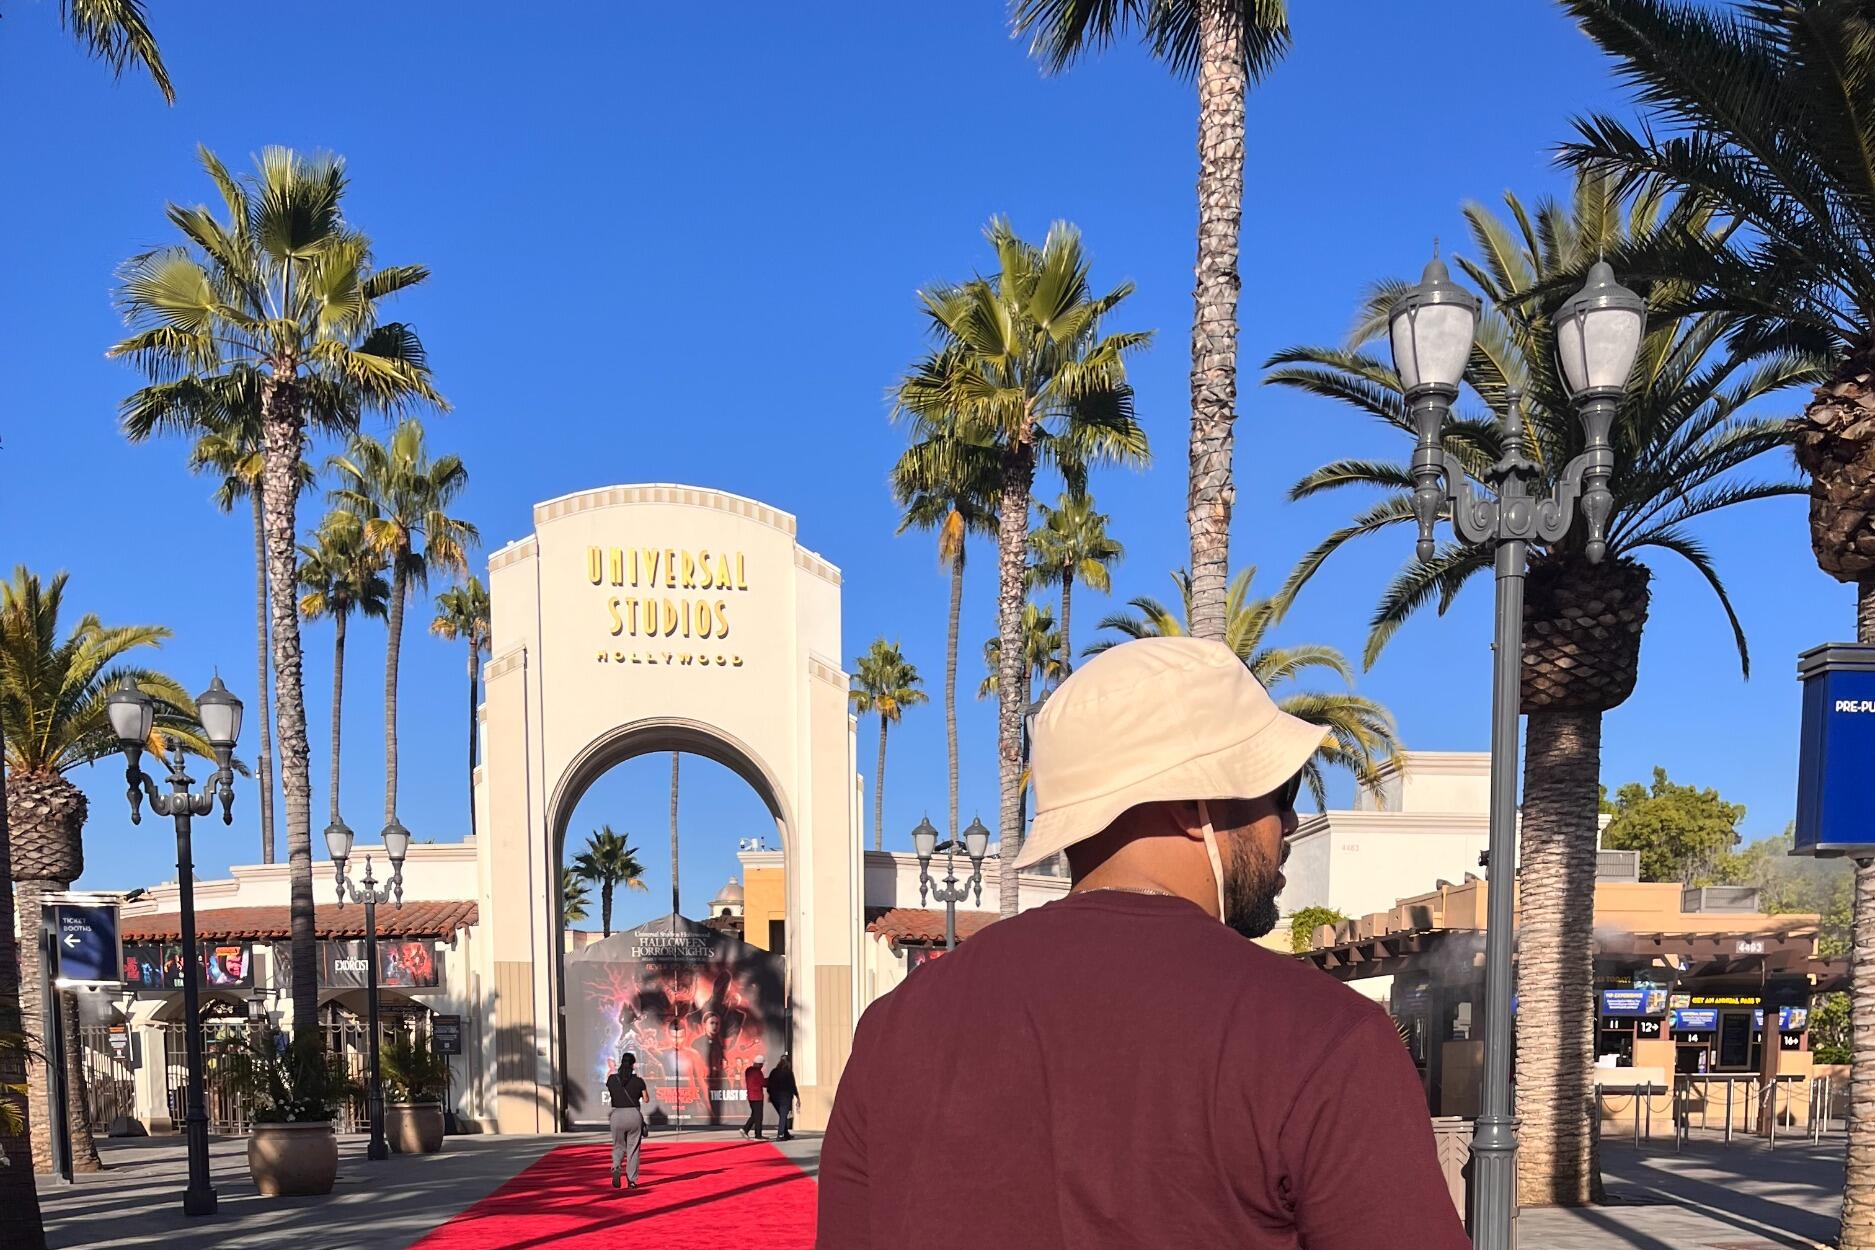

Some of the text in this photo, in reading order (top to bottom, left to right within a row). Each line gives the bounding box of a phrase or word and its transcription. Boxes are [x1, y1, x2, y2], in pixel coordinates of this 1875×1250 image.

[586, 546, 748, 591] UNIVERSAL
[607, 596, 729, 639] STUDIOS
[595, 650, 744, 667] HOLLYWOOD
[640, 937, 706, 947] HALLOWEEN
[631, 946, 715, 958] HORROR NIGHTS
[334, 959, 369, 971] EXORCIST
[1609, 1020, 1619, 1029] 11
[1640, 1022, 1652, 1033] 12
[1687, 1034, 1699, 1043] 14
[1784, 1035, 1793, 1046] 16
[710, 1089, 722, 1101] THE
[722, 1089, 739, 1101] LAST
